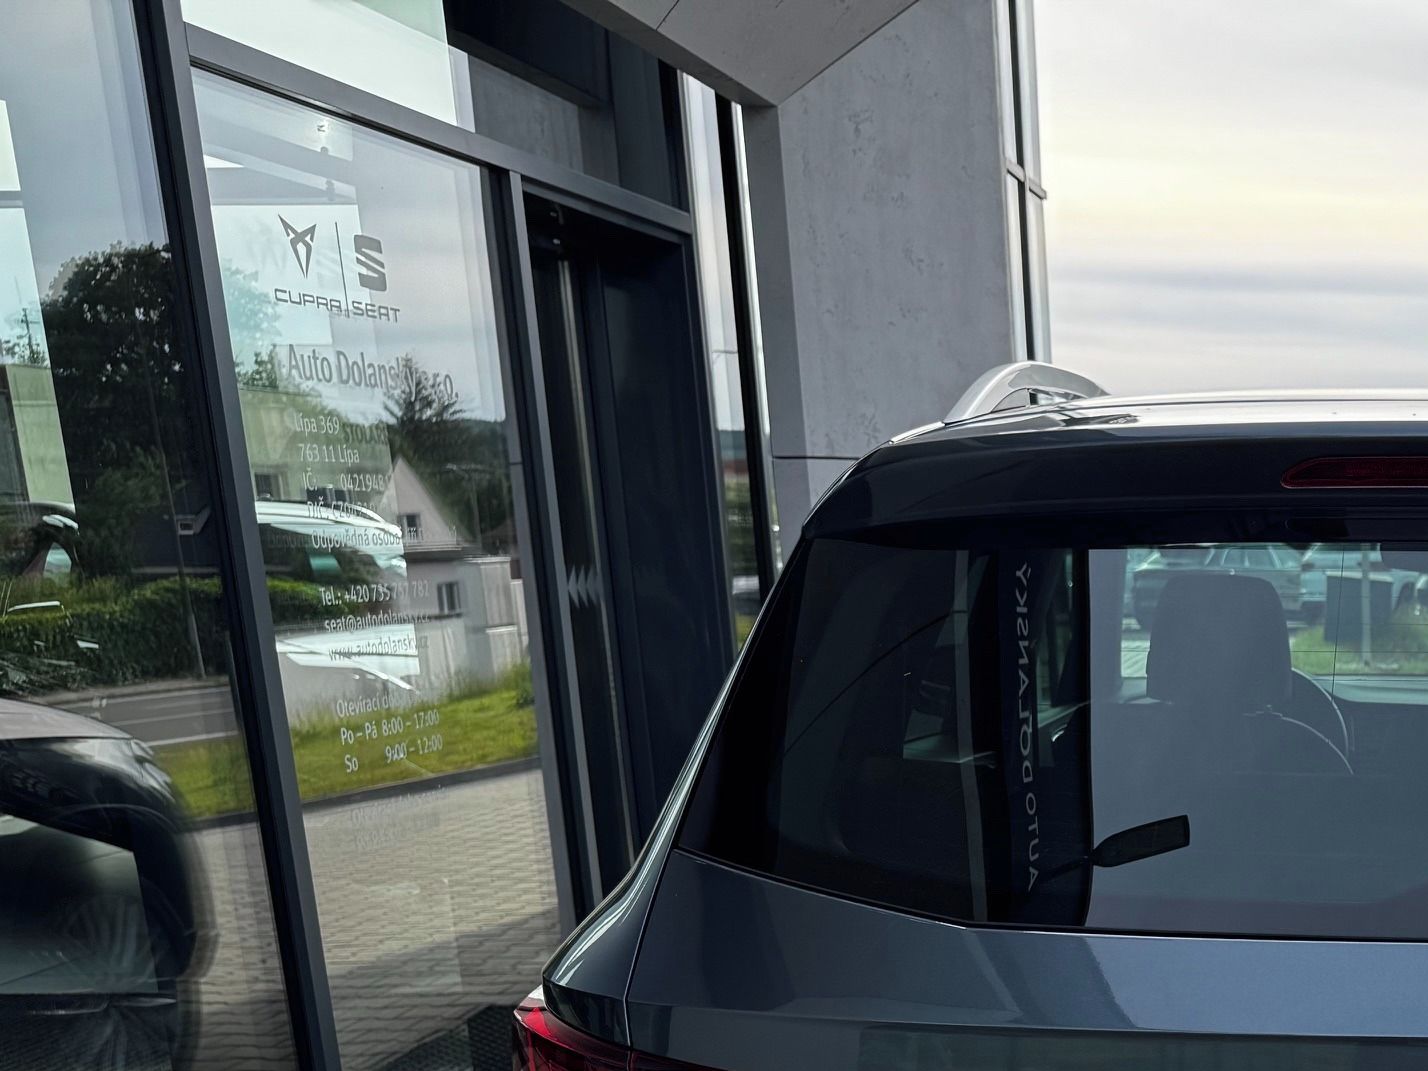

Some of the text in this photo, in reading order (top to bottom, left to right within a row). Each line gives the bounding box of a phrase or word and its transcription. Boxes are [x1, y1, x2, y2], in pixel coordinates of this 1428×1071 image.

[274, 288, 343, 313] CUPRA
[352, 300, 400, 323] SEAT
[288, 343, 332, 384] Auto
[320, 415, 340, 435] 369
[298, 443, 320, 462] 763
[323, 445, 336, 462] 11
[345, 583, 370, 603] +420
[341, 727, 355, 746] Po
[365, 720, 378, 740] Pá
[382, 716, 404, 736] 8:00
[414, 709, 440, 729] 17:00
[344, 754, 359, 773] So
[418, 734, 443, 755] 12:00
